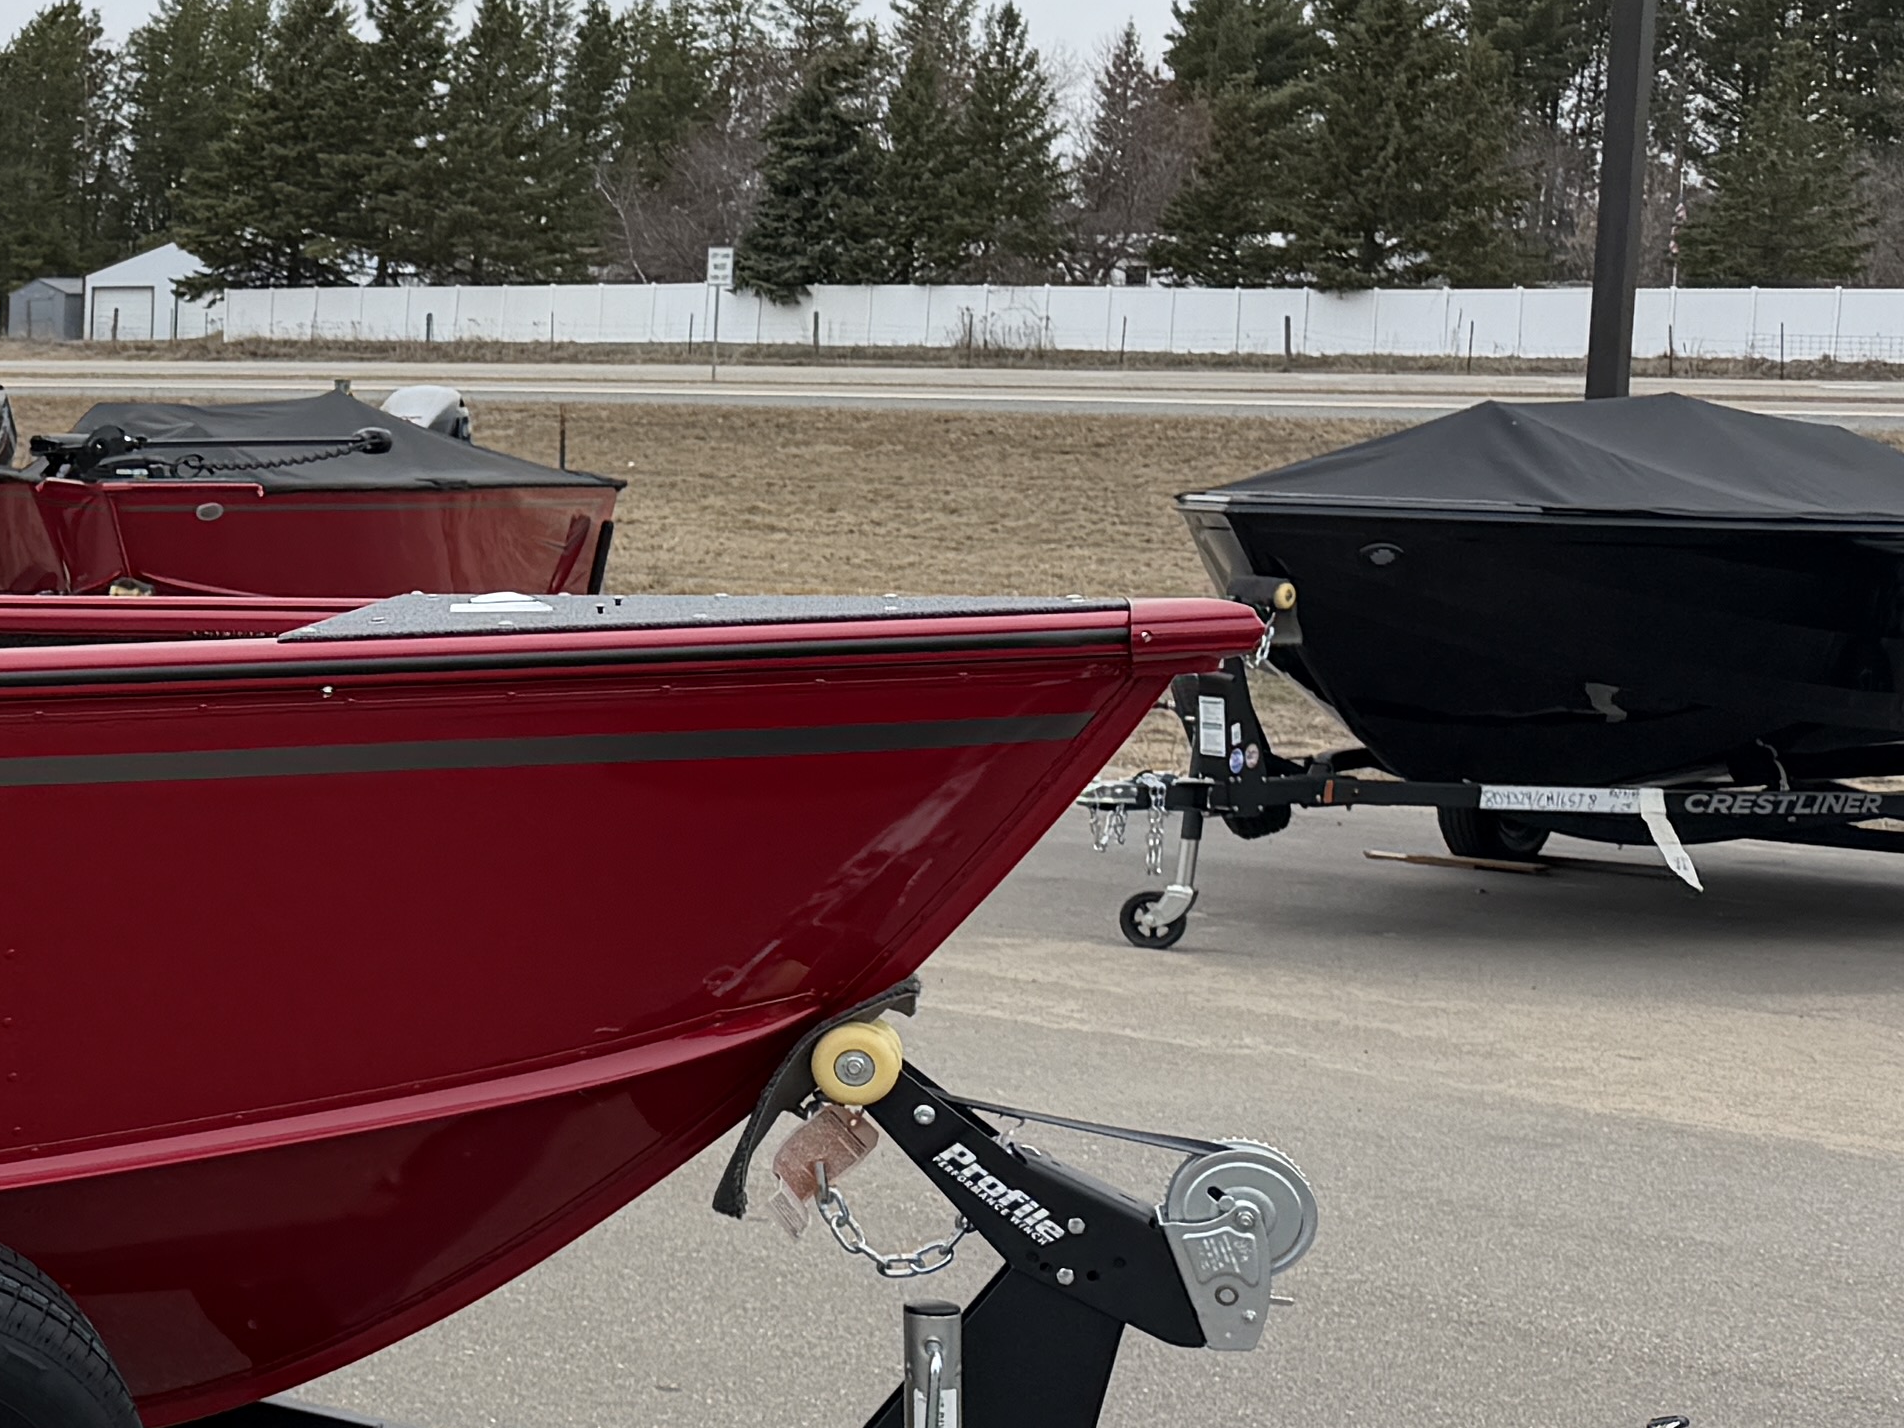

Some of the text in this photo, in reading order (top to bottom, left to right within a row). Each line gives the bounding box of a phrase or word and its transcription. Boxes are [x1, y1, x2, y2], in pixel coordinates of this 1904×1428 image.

[1684, 793, 1883, 815] CRESTLINER
[932, 1155, 1049, 1246] PERFORMANCE WINCH
[939, 1141, 1066, 1243] Profile
